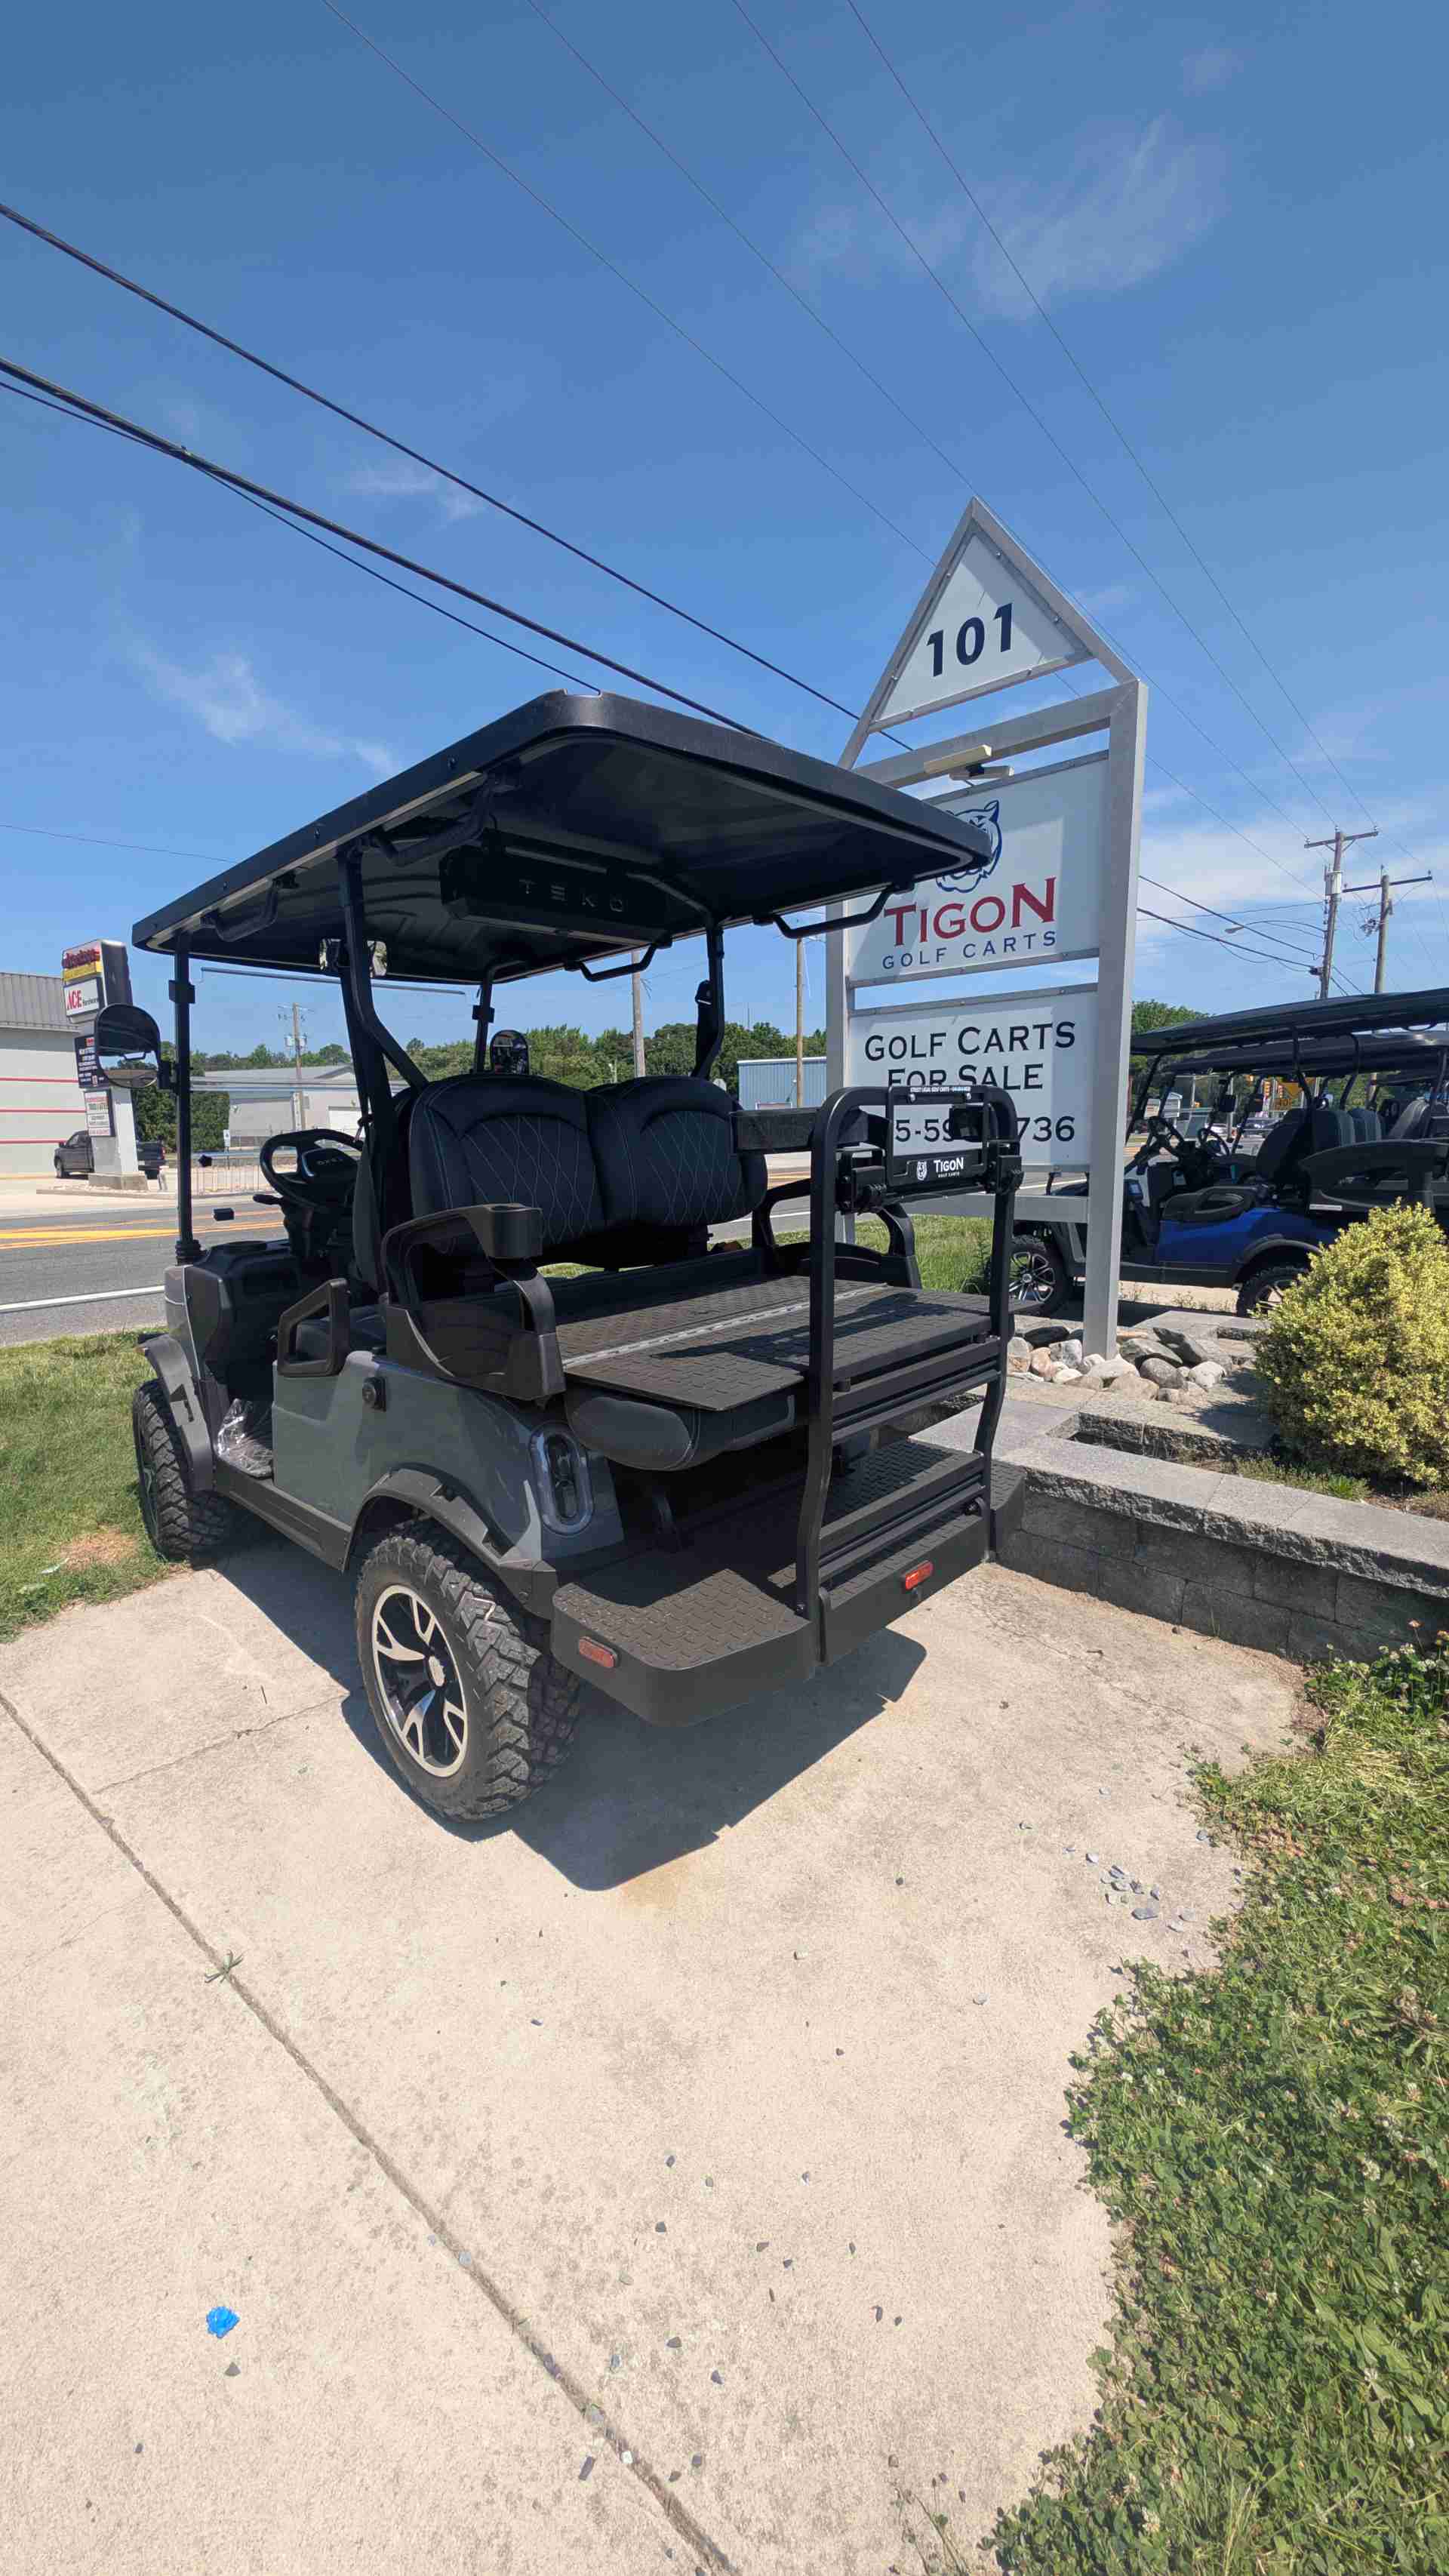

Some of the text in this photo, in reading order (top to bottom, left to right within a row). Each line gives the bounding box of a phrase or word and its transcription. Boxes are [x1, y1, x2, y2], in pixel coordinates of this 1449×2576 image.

[926, 602, 1013, 677] 101
[884, 876, 1057, 946] TIGON
[882, 931, 1056, 969] GOLF CARTS
[67, 989, 82, 1011] ACE
[865, 1021, 1075, 1061] GOLF CARTS
[888, 1063, 1043, 1091] FOR SALE
[934, 1157, 964, 1173] TIGON
